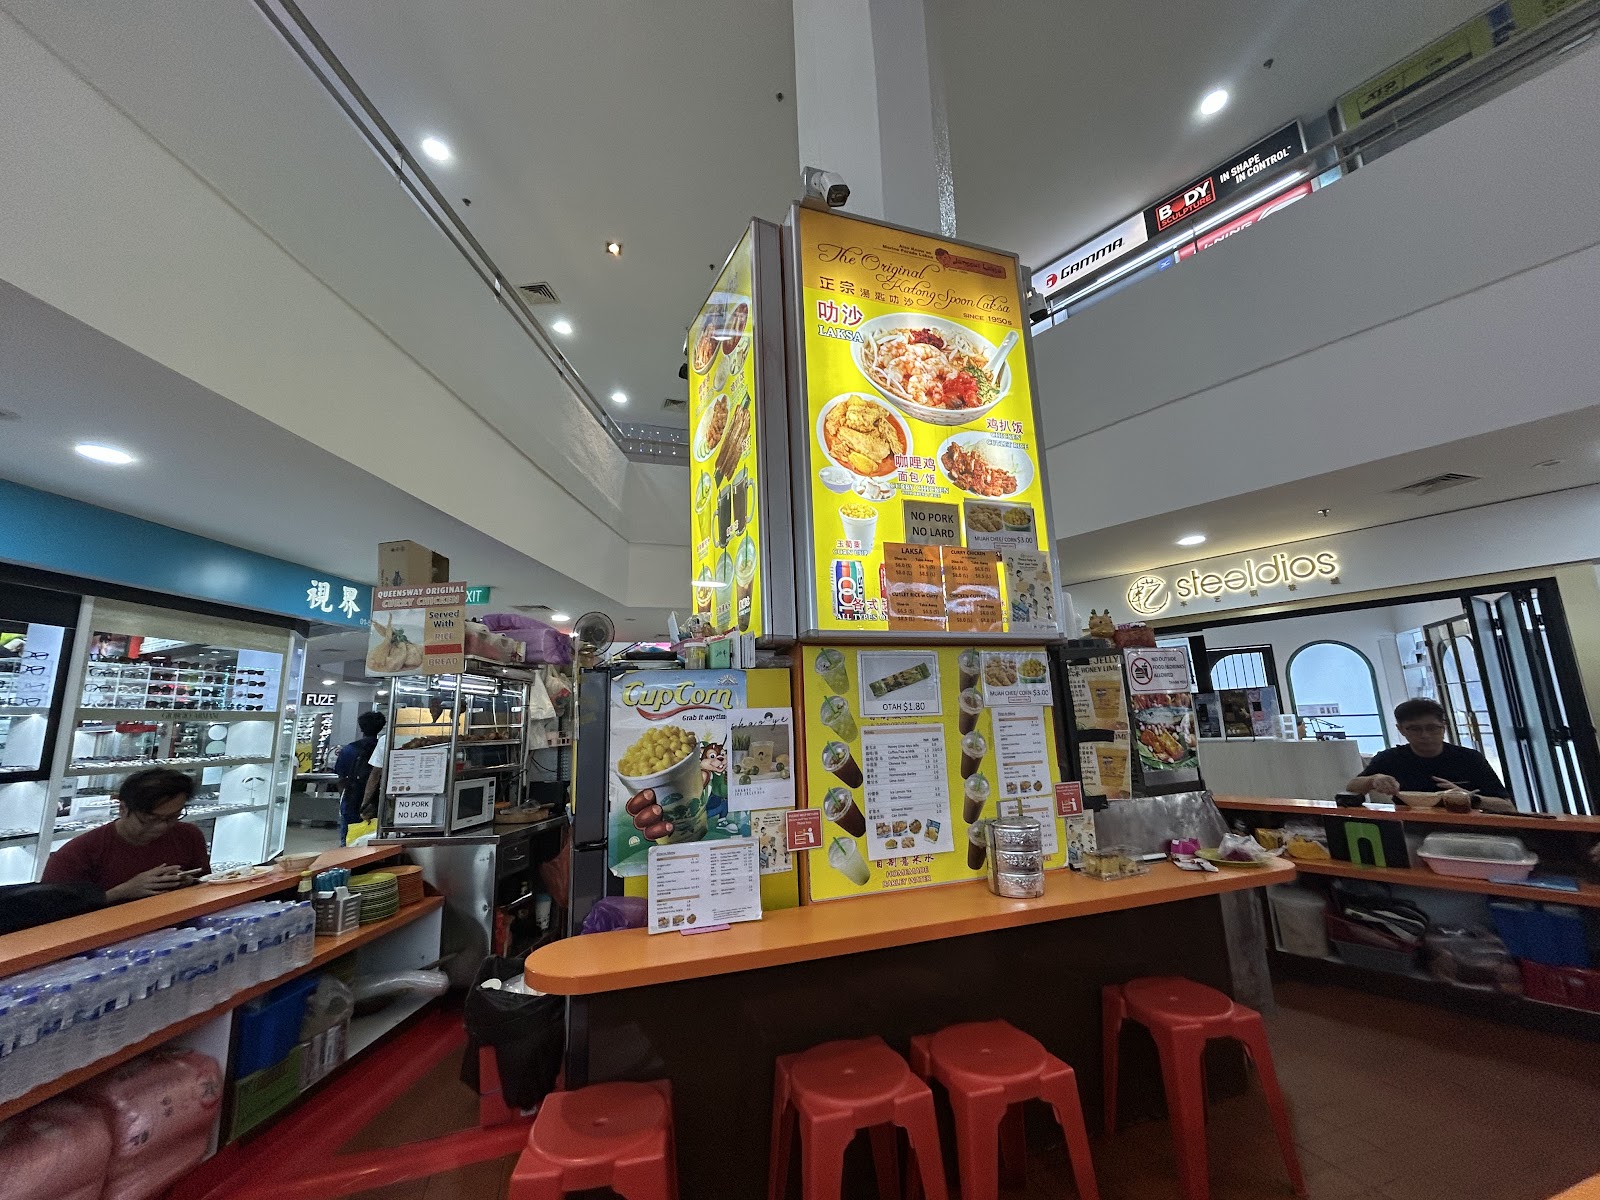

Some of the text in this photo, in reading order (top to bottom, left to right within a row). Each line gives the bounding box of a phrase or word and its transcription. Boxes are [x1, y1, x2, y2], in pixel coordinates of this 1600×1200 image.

[1220, 153, 1261, 184] IN SHAPE
[1236, 172, 1247, 184] IN
[1161, 194, 1213, 227] SCULPTURE
[818, 243, 941, 284] The Original
[1060, 237, 1124, 280] GAMMA
[882, 279, 1011, 313] Katong Spoon Laksa
[818, 300, 863, 327] 叻沙
[962, 312, 1013, 326] SINCE 1950s
[818, 324, 865, 344] LAKSA
[986, 418, 1024, 434] 鸡扒饭
[889, 482, 950, 495] CURRY CHICKEN
[910, 511, 955, 524] NO PORK
[912, 526, 955, 538] NO LARD
[901, 547, 923, 555] LAKSA
[1175, 552, 1338, 598] steeldios
[377, 585, 465, 599] QUEENSWAY ORIGINAL
[465, 589, 483, 603] XIT
[306, 579, 361, 619] 視界
[381, 595, 460, 608] CURRY CHICKEN
[429, 610, 460, 619] Served
[853, 613, 878, 621] TYPES
[433, 619, 454, 628] With
[434, 632, 454, 641] RICE
[428, 657, 458, 666] BREAD
[1093, 655, 1119, 665] JELLY
[305, 693, 336, 706] FUZE
[622, 680, 734, 712] CupCorn
[1032, 689, 1049, 697] $3.00
[882, 702, 926, 712] OTAH $1.80
[682, 714, 697, 722] Grab
[704, 714, 727, 722] anytim
[886, 866, 929, 878] HOMEMADE
